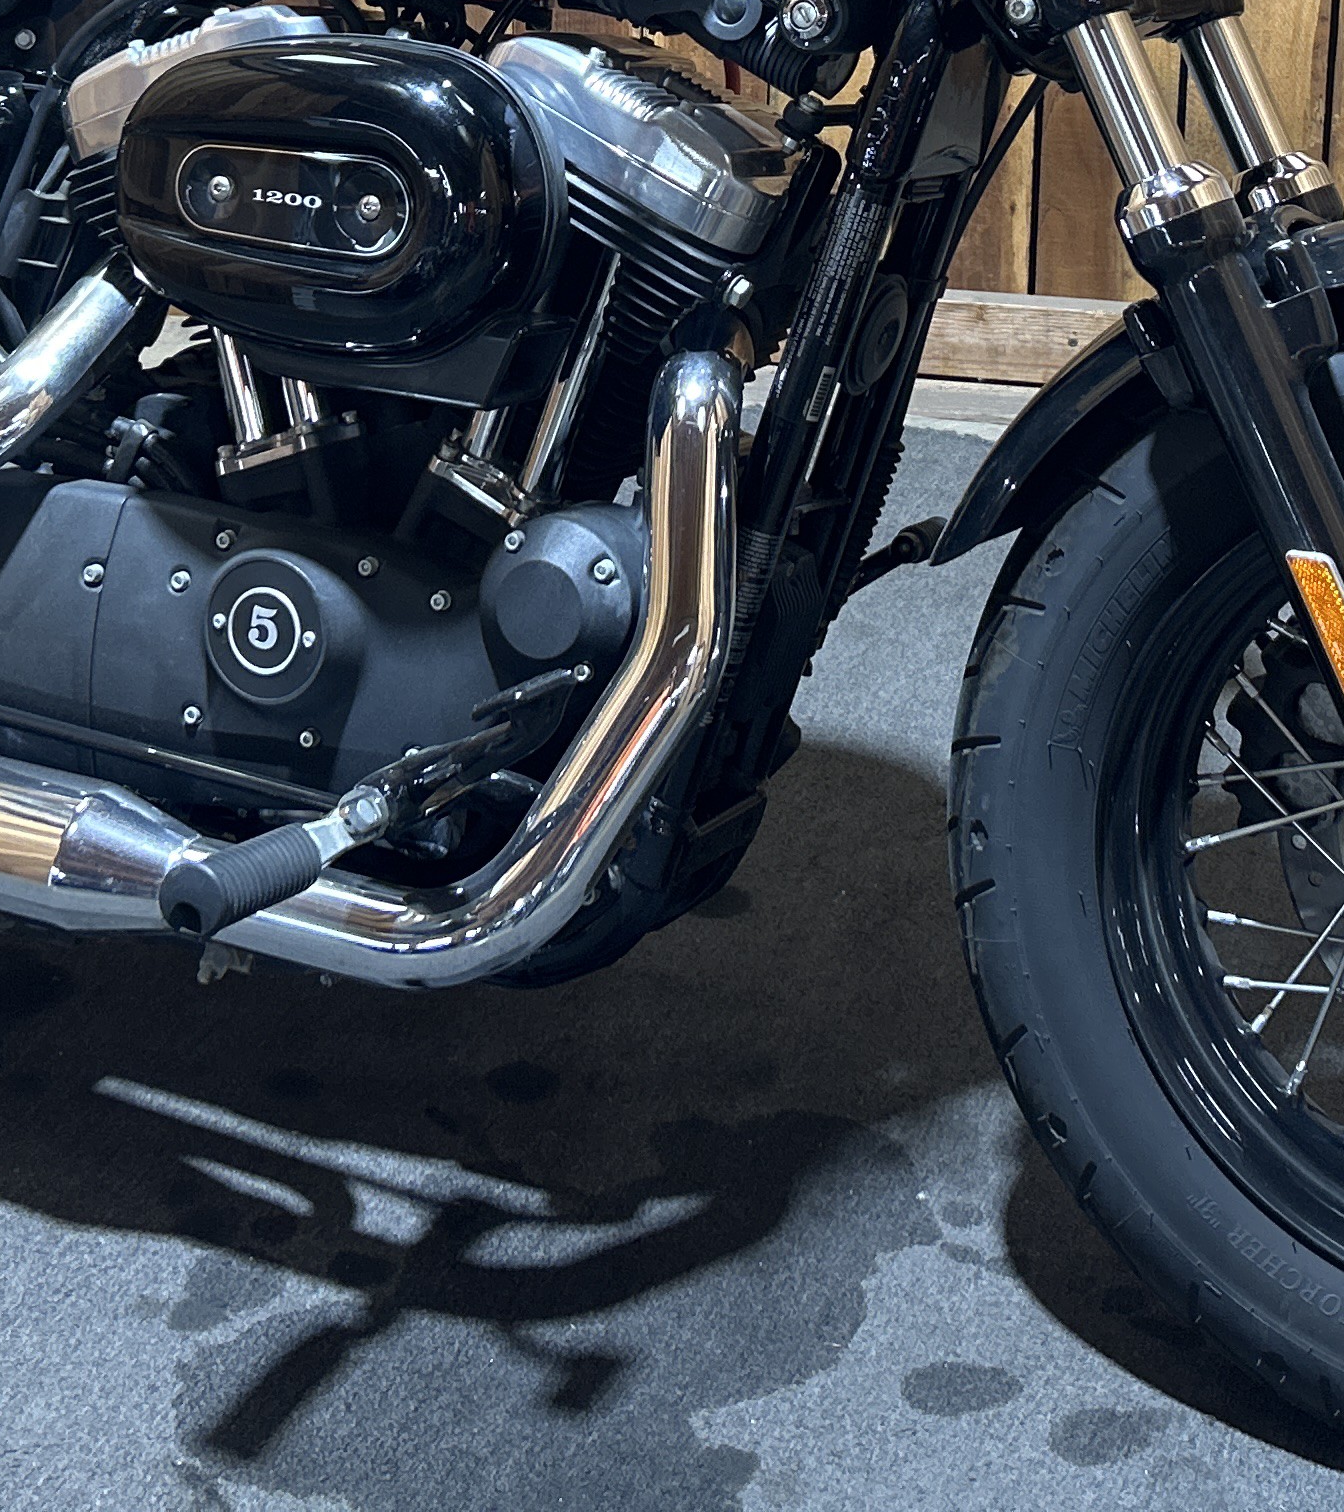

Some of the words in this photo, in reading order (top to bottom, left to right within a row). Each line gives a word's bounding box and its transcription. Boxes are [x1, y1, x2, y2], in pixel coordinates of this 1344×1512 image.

[252, 188, 322, 209] 1200
[247, 603, 279, 651] 5
[1068, 539, 1175, 706] MICHELIN
